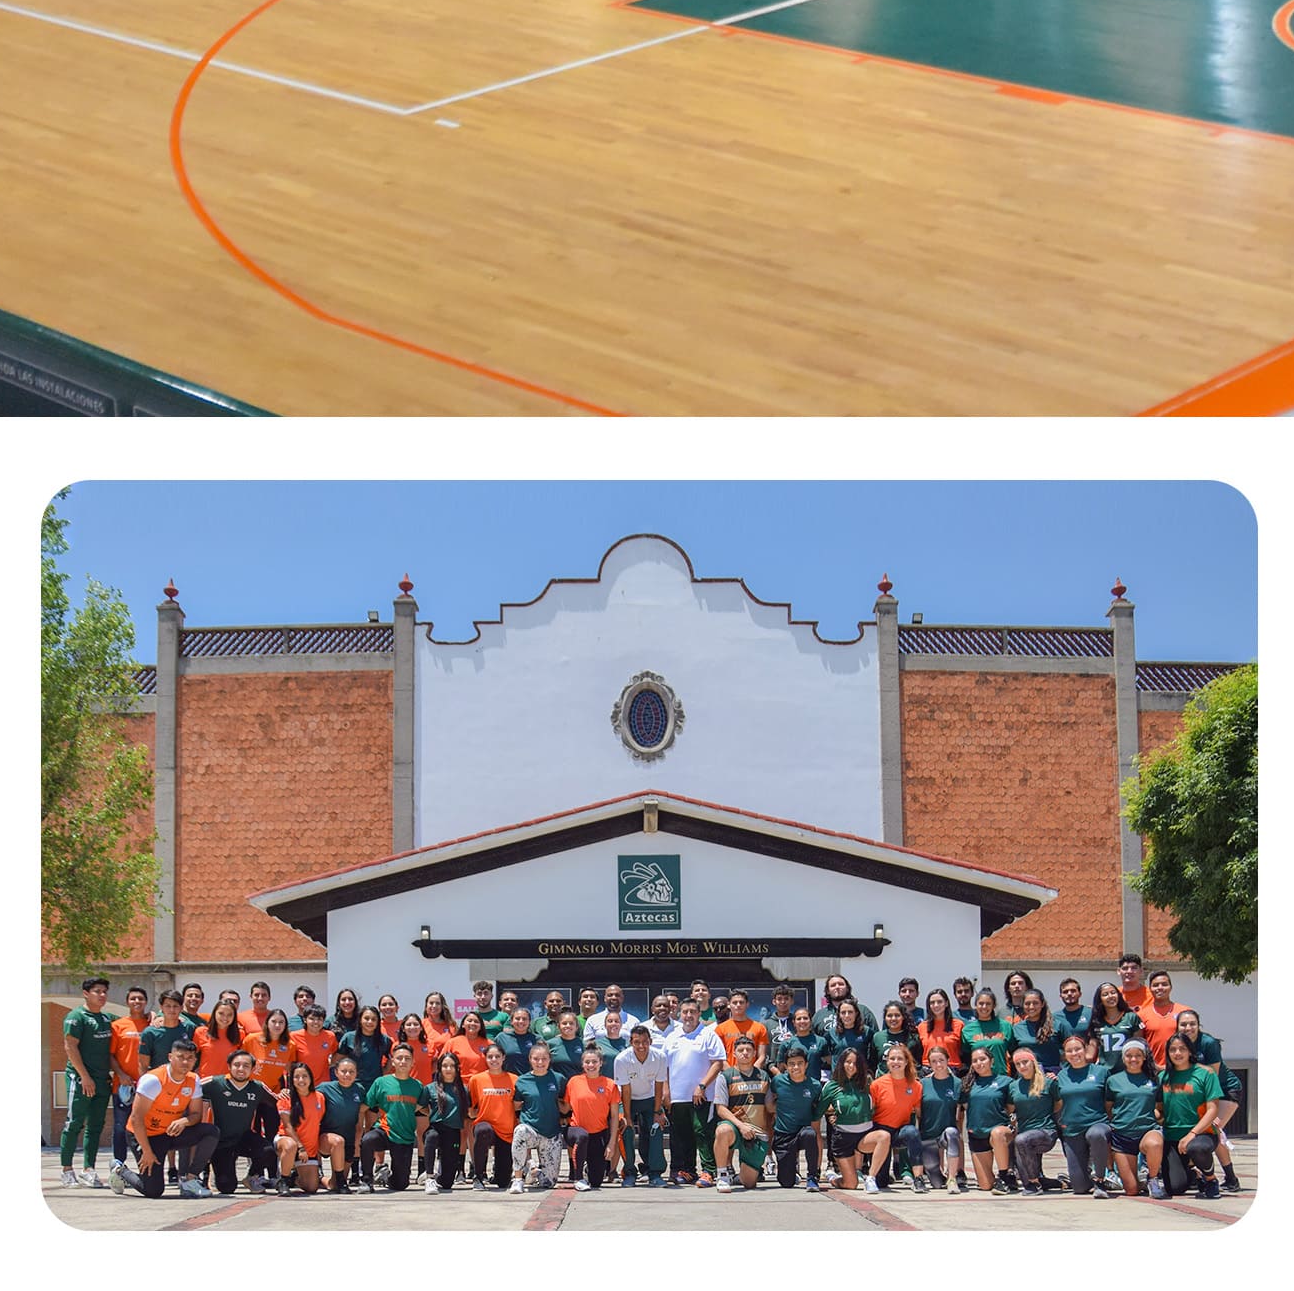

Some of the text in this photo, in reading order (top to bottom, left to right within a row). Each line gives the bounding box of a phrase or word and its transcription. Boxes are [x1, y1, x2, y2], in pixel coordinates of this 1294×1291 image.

[16, 367, 34, 385] LAS
[34, 372, 105, 414] INSTALACIONES
[625, 912, 676, 923] Aztecas
[538, 941, 770, 955] GIMNASIO MORRIS MOE WILLIAMS
[1100, 1034, 1127, 1052] 12
